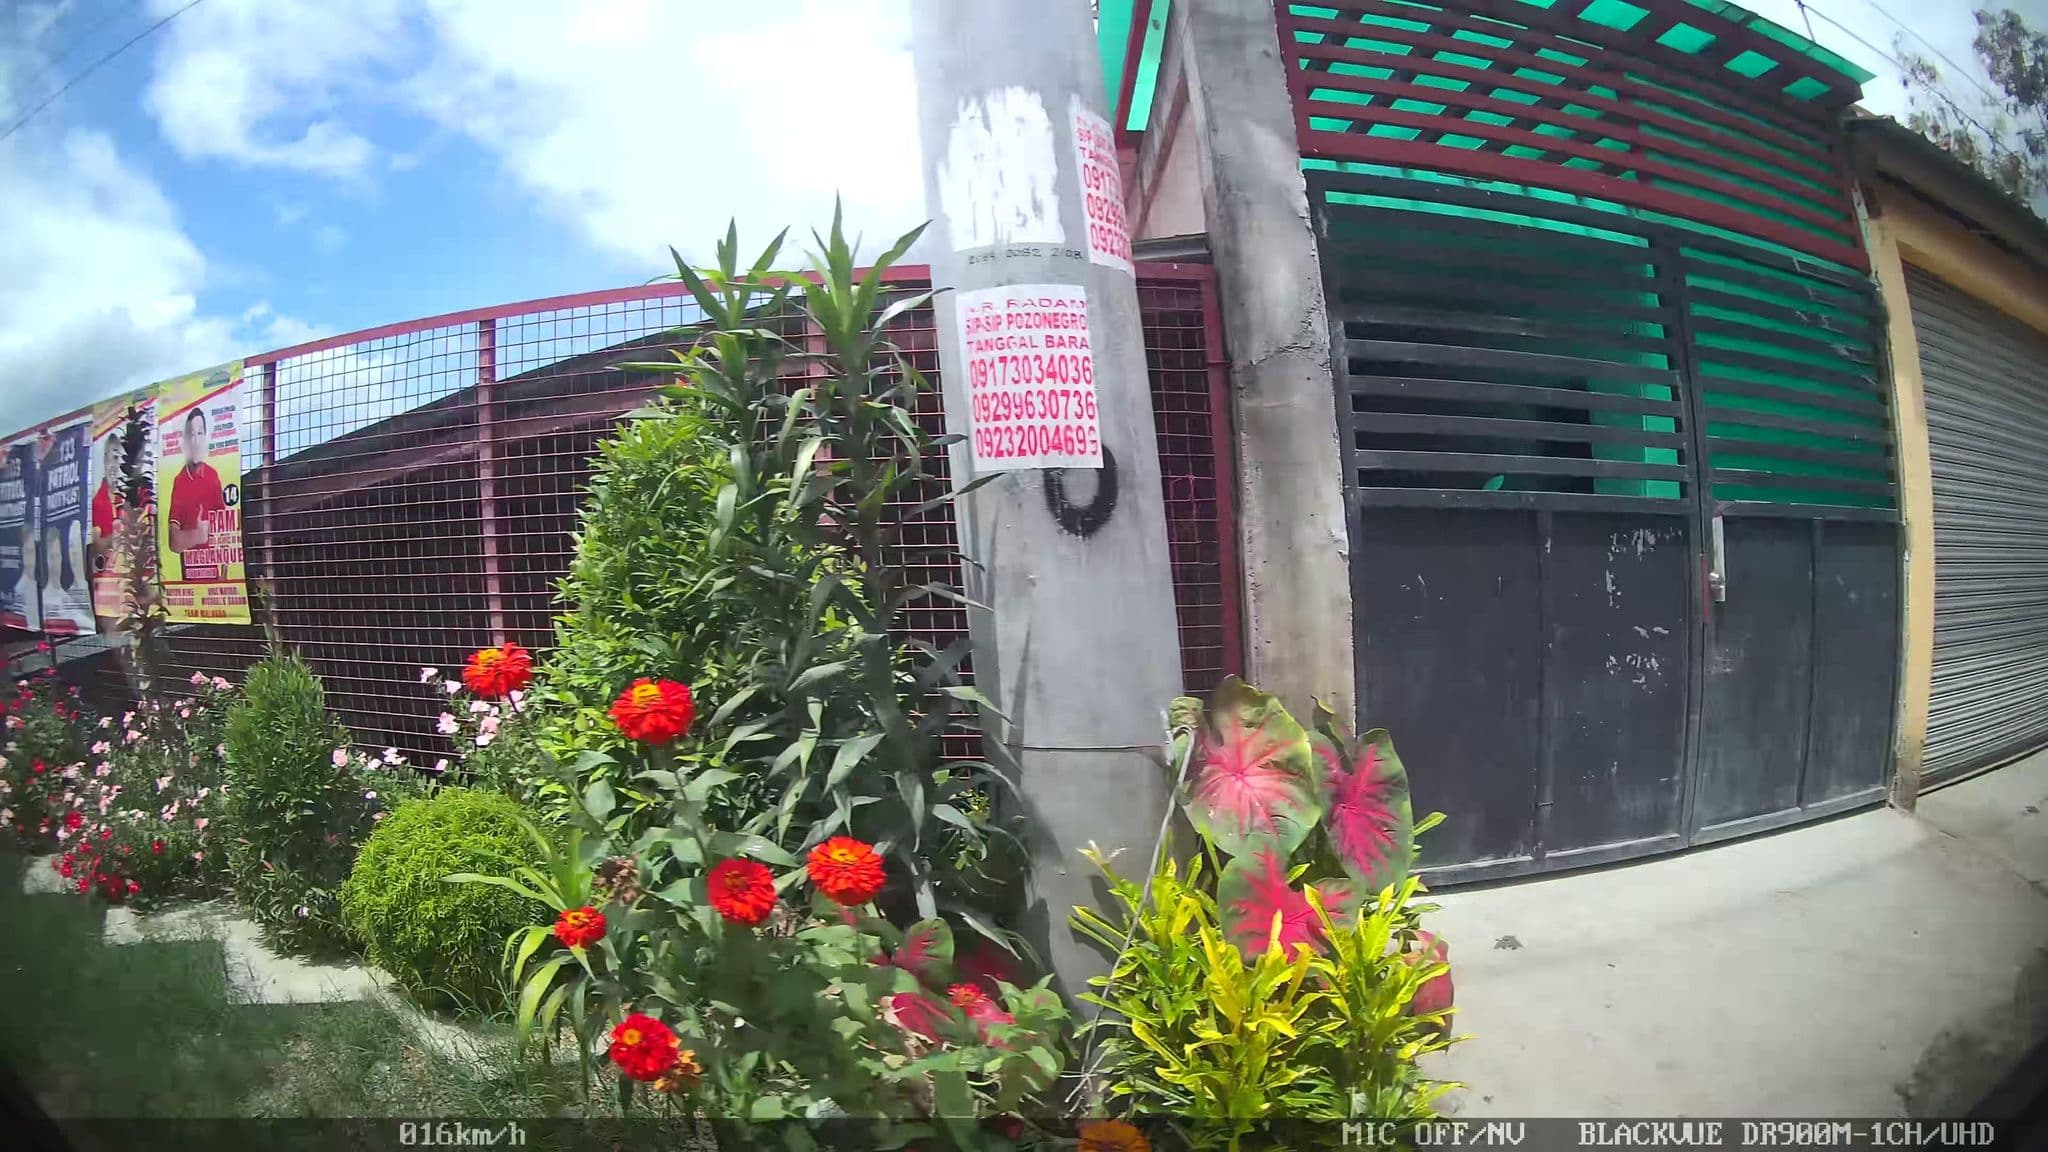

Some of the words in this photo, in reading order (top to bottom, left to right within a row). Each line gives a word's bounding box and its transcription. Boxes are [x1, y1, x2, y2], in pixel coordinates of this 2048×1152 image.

[1007, 312, 1087, 331] POZONEGRO
[966, 335, 1039, 353] TANGGAL
[1045, 335, 1089, 350] BARA
[970, 354, 1093, 388] 09173034036
[973, 389, 1096, 423] 09299630736
[224, 487, 238, 503] 14
